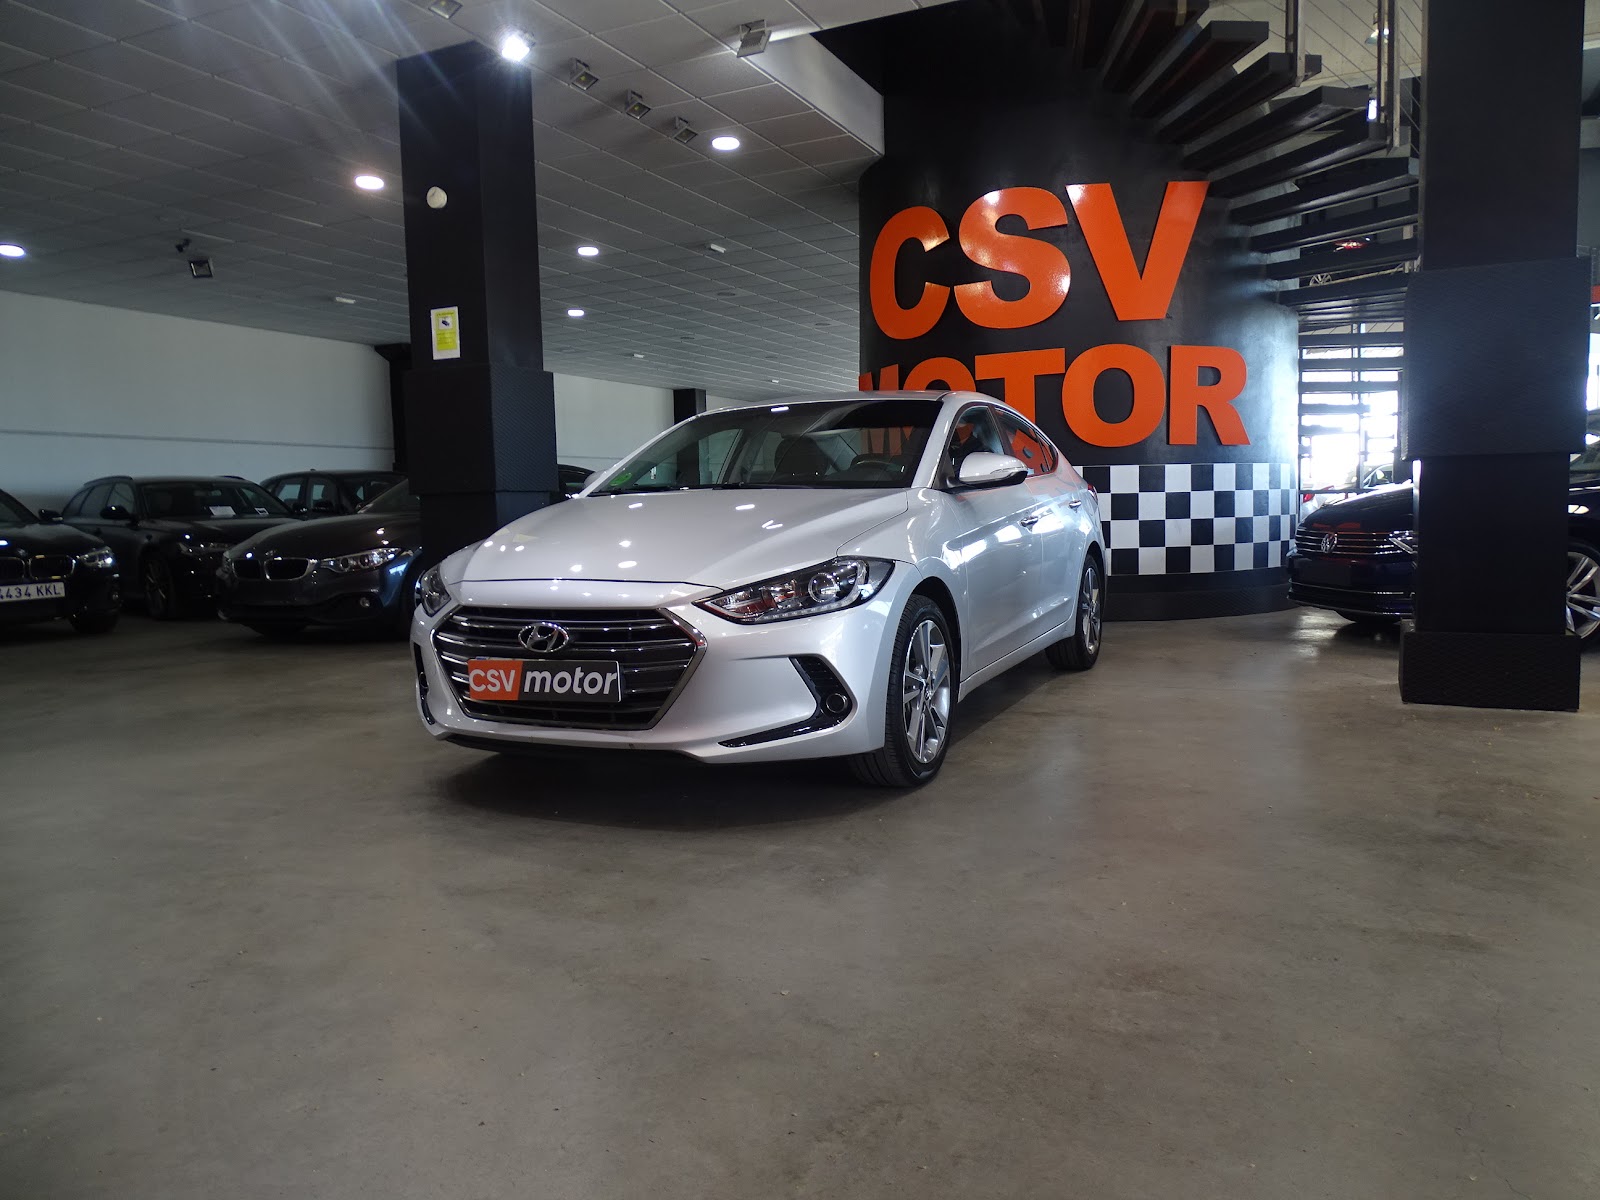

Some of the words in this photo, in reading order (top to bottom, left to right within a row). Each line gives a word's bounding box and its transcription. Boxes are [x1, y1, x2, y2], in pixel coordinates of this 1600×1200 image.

[869, 180, 1210, 340] CSV
[36, 584, 60, 596] KKL
[469, 668, 515, 692] CSV
[524, 667, 617, 695] motor
